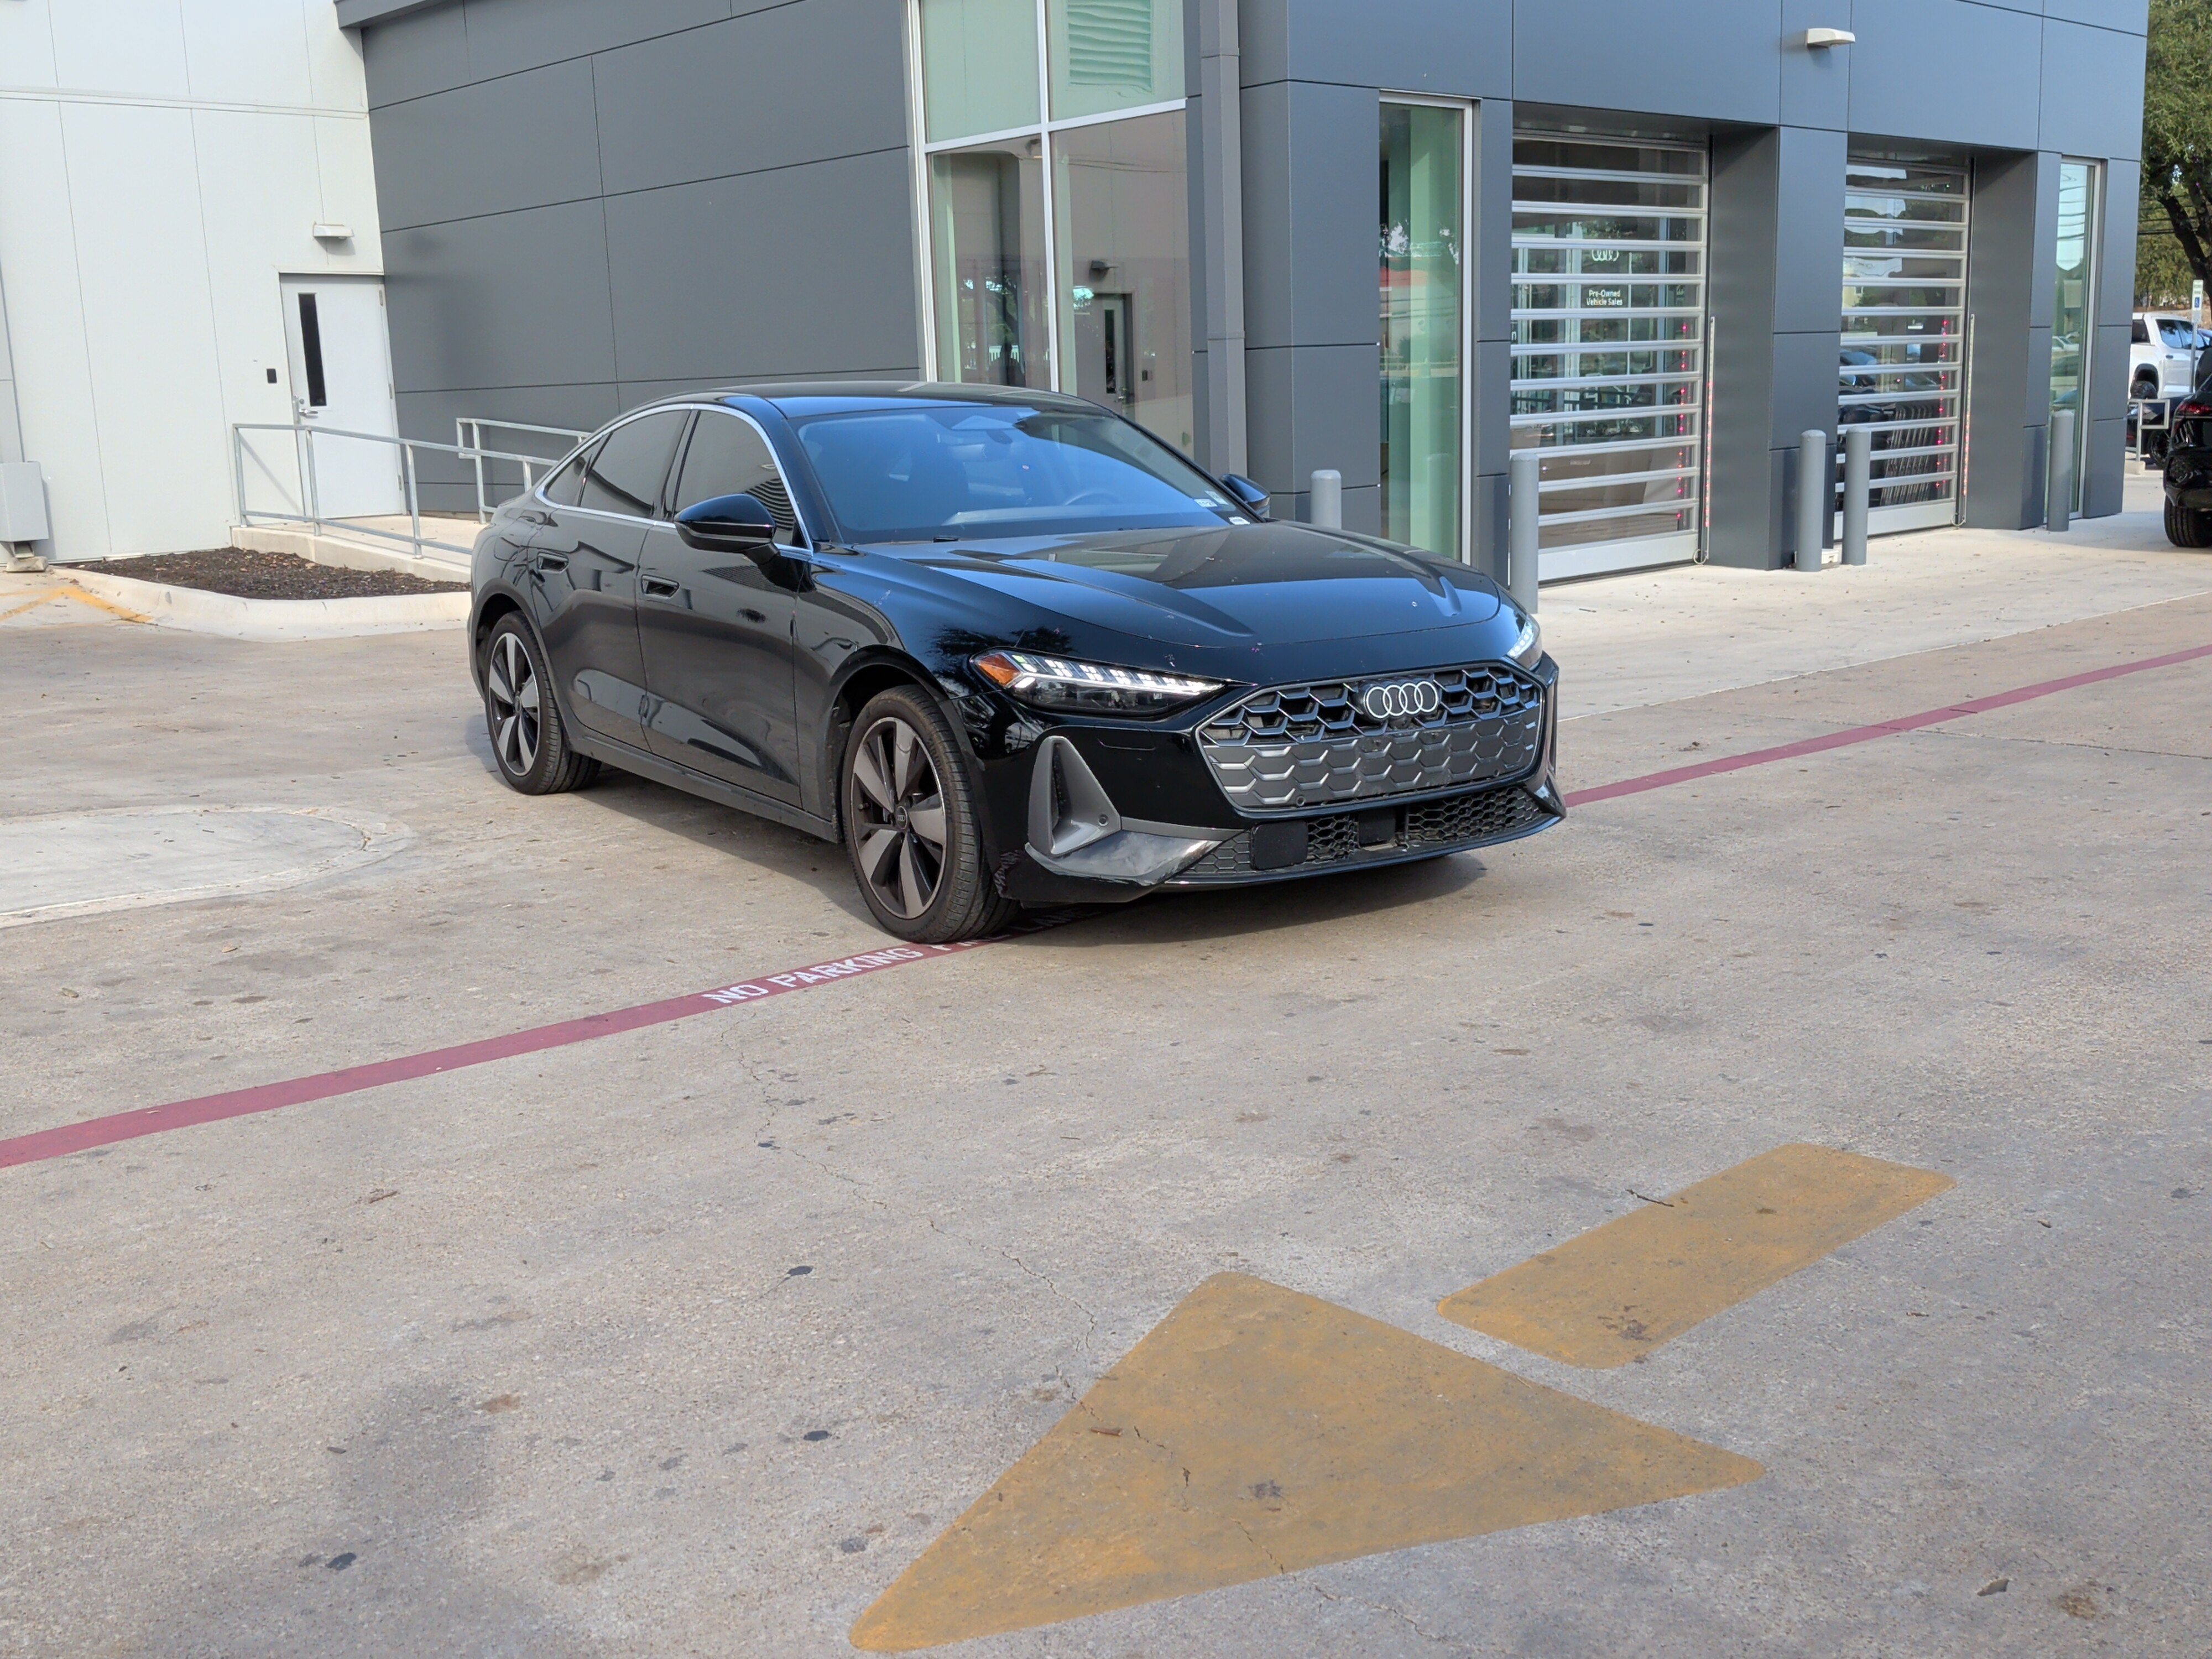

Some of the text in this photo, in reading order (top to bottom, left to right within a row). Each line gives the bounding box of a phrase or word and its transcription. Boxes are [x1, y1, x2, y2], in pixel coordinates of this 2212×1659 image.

[1588, 289, 1621, 298] Pre-Owned
[703, 984, 769, 1004] NO
[766, 948, 924, 988] PARKING
